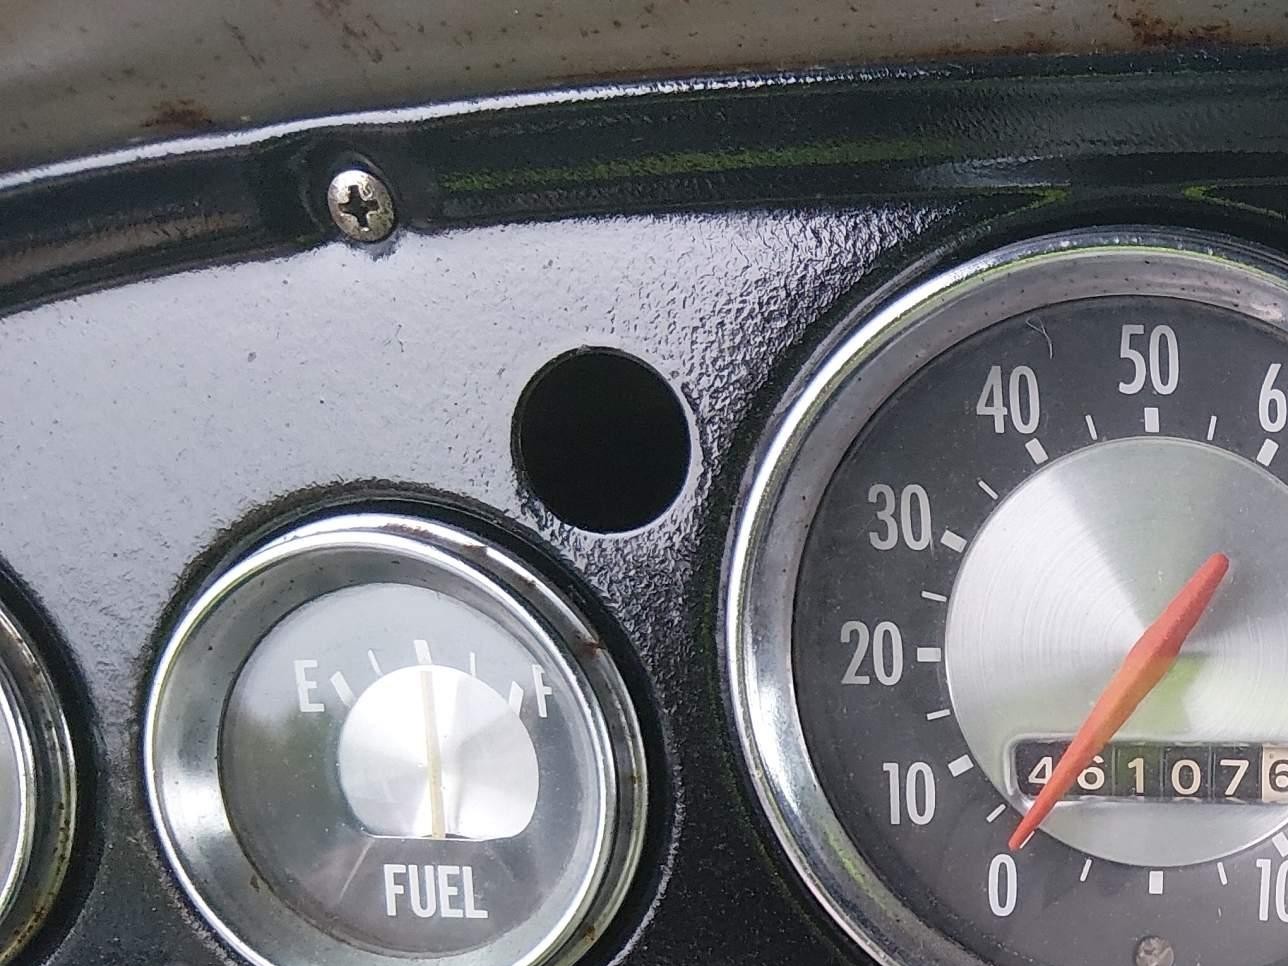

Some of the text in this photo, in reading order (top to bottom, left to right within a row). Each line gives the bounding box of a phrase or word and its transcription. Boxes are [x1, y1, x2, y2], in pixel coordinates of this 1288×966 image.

[1118, 325, 1179, 395] 50
[977, 366, 1041, 434] 40
[869, 484, 931, 550] 30
[841, 621, 903, 686] 20
[293, 660, 325, 712] E
[883, 762, 936, 825] 10
[383, 864, 488, 919] FUEL
[988, 854, 1018, 917] 0
